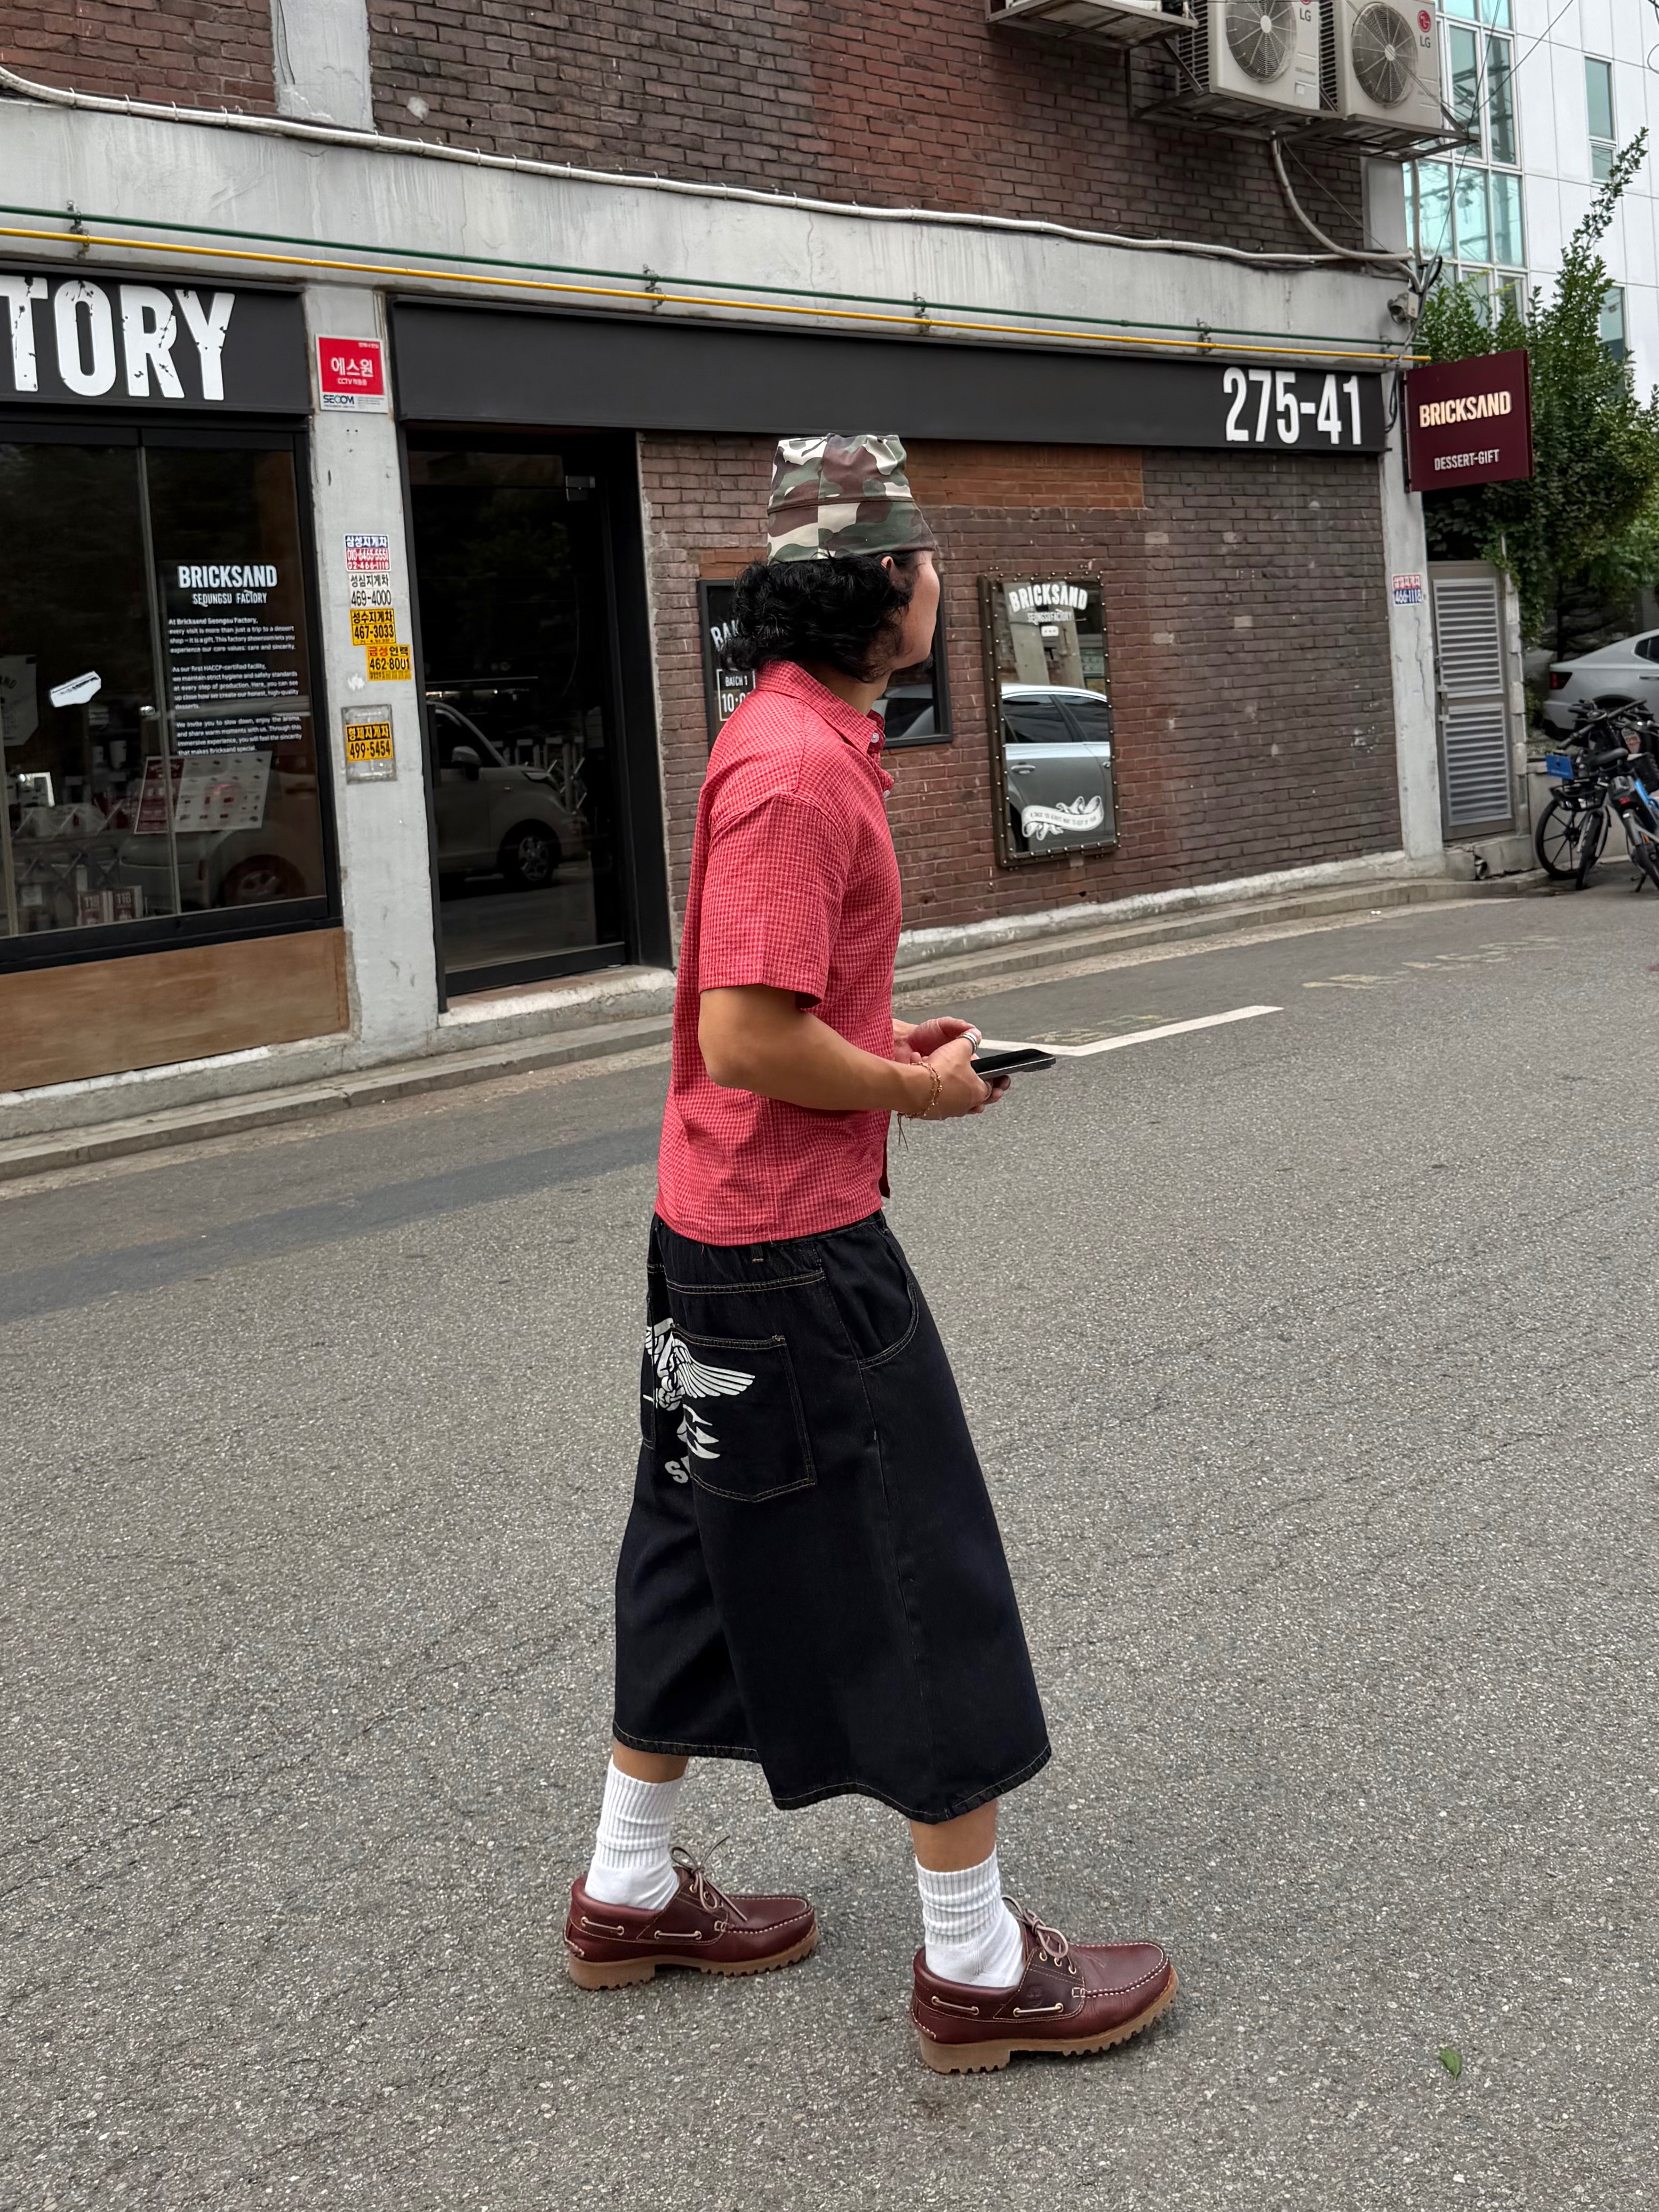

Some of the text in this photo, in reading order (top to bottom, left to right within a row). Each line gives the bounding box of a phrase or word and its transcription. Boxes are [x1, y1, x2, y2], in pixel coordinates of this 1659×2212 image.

[1299, 8, 1311, 22] LG
[1419, 36, 1431, 49] LG
[0, 277, 235, 400] TORY
[331, 357, 373, 377] 에스원
[323, 395, 354, 404] SECOM
[1223, 367, 1362, 445] 275-41
[1419, 391, 1512, 428] BRICKSAND
[1434, 449, 1500, 471] DESSERT-GIFT
[178, 565, 277, 588] BRICKSAND
[350, 574, 388, 587] 성심지게차
[236, 590, 267, 604] FACTORY
[351, 590, 391, 606] 469-4000
[1009, 584, 1088, 612] BRICKSAND
[353, 610, 392, 624] 성수지게차
[354, 625, 394, 639] 467-3033
[725, 675, 747, 687] BATCH 1
